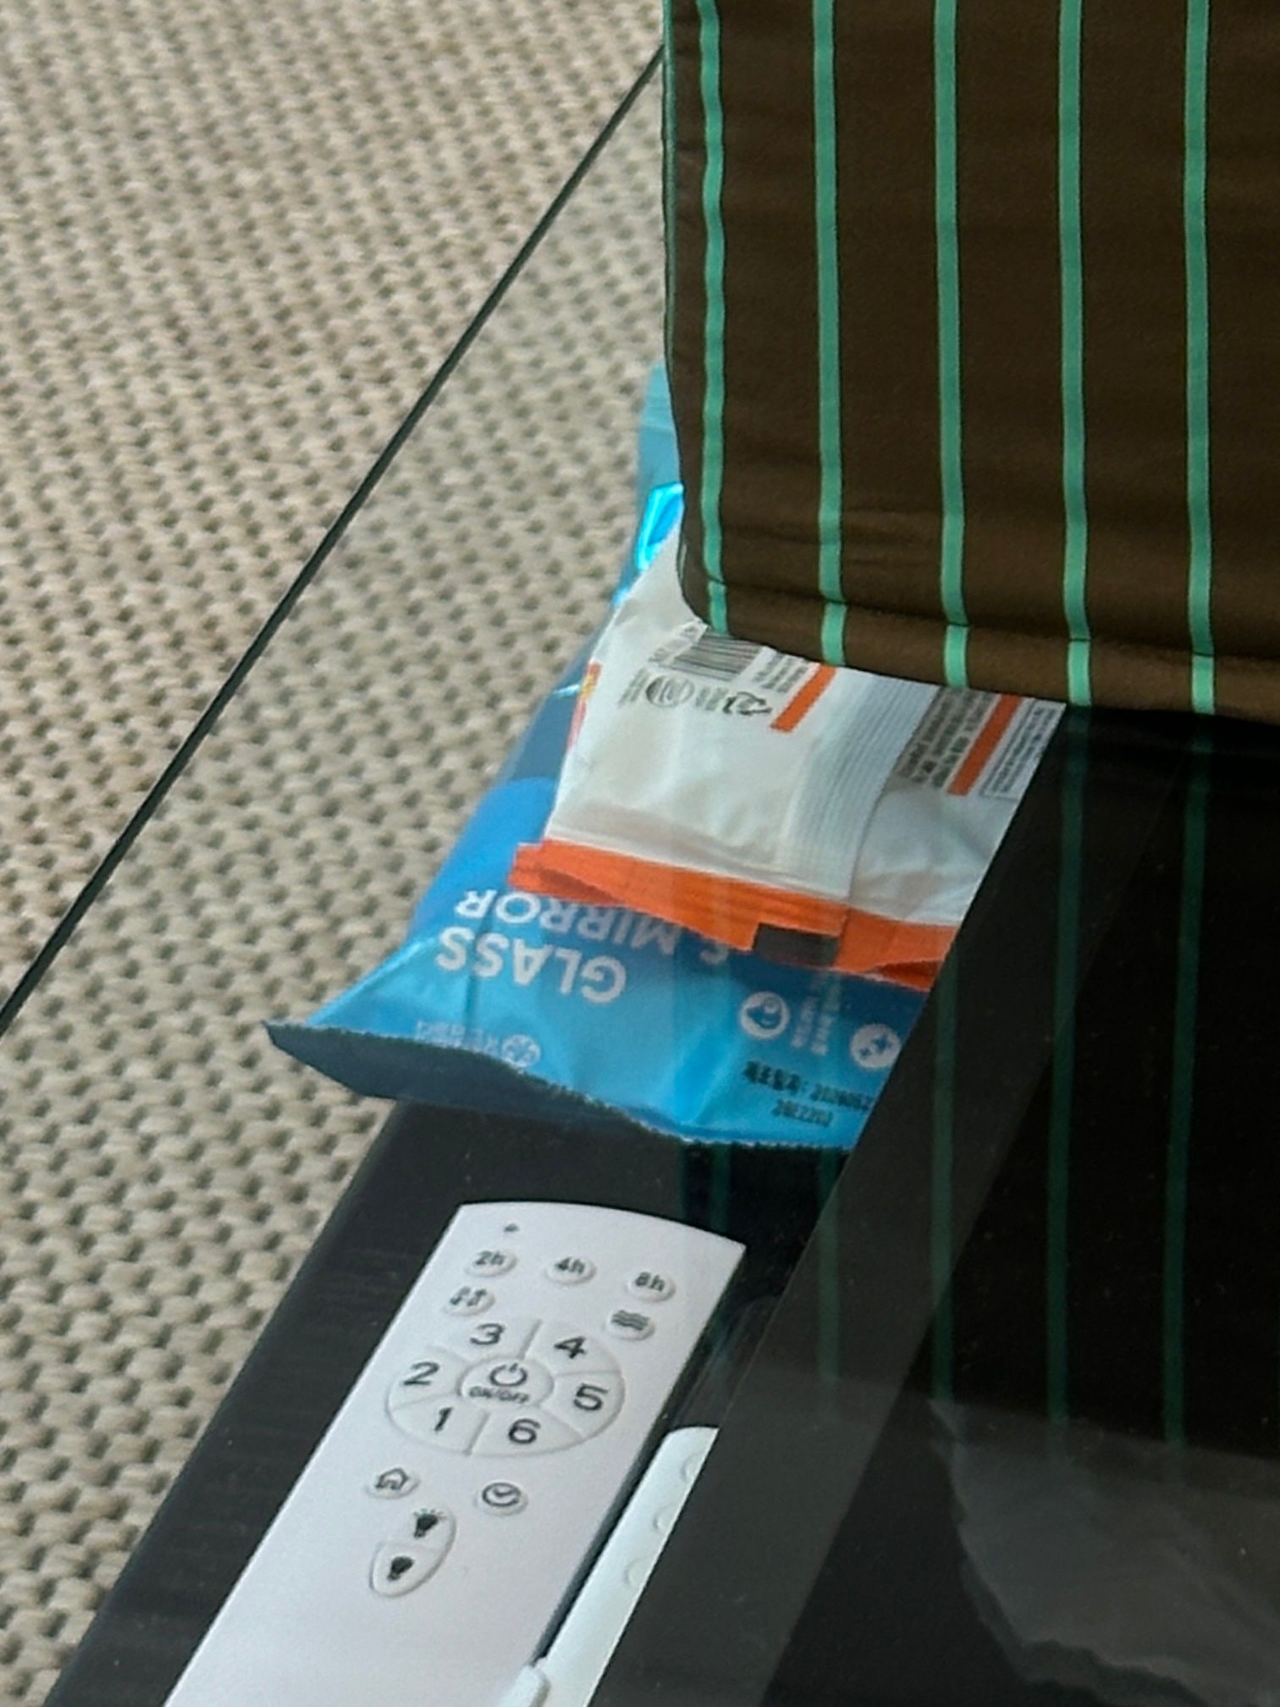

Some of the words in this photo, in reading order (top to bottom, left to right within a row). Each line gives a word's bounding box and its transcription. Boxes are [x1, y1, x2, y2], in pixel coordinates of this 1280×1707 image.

[454, 889, 683, 956] MIRROR
[434, 926, 627, 1004] GLASS
[474, 1250, 506, 1267] 2h
[554, 1257, 586, 1276] 4h
[634, 1271, 666, 1292] 8h
[469, 1322, 506, 1346] 3
[553, 1336, 588, 1360] 4
[403, 1361, 441, 1387] 2
[573, 1383, 609, 1412] 5
[433, 1406, 453, 1433] 1
[507, 1418, 541, 1446] 6
